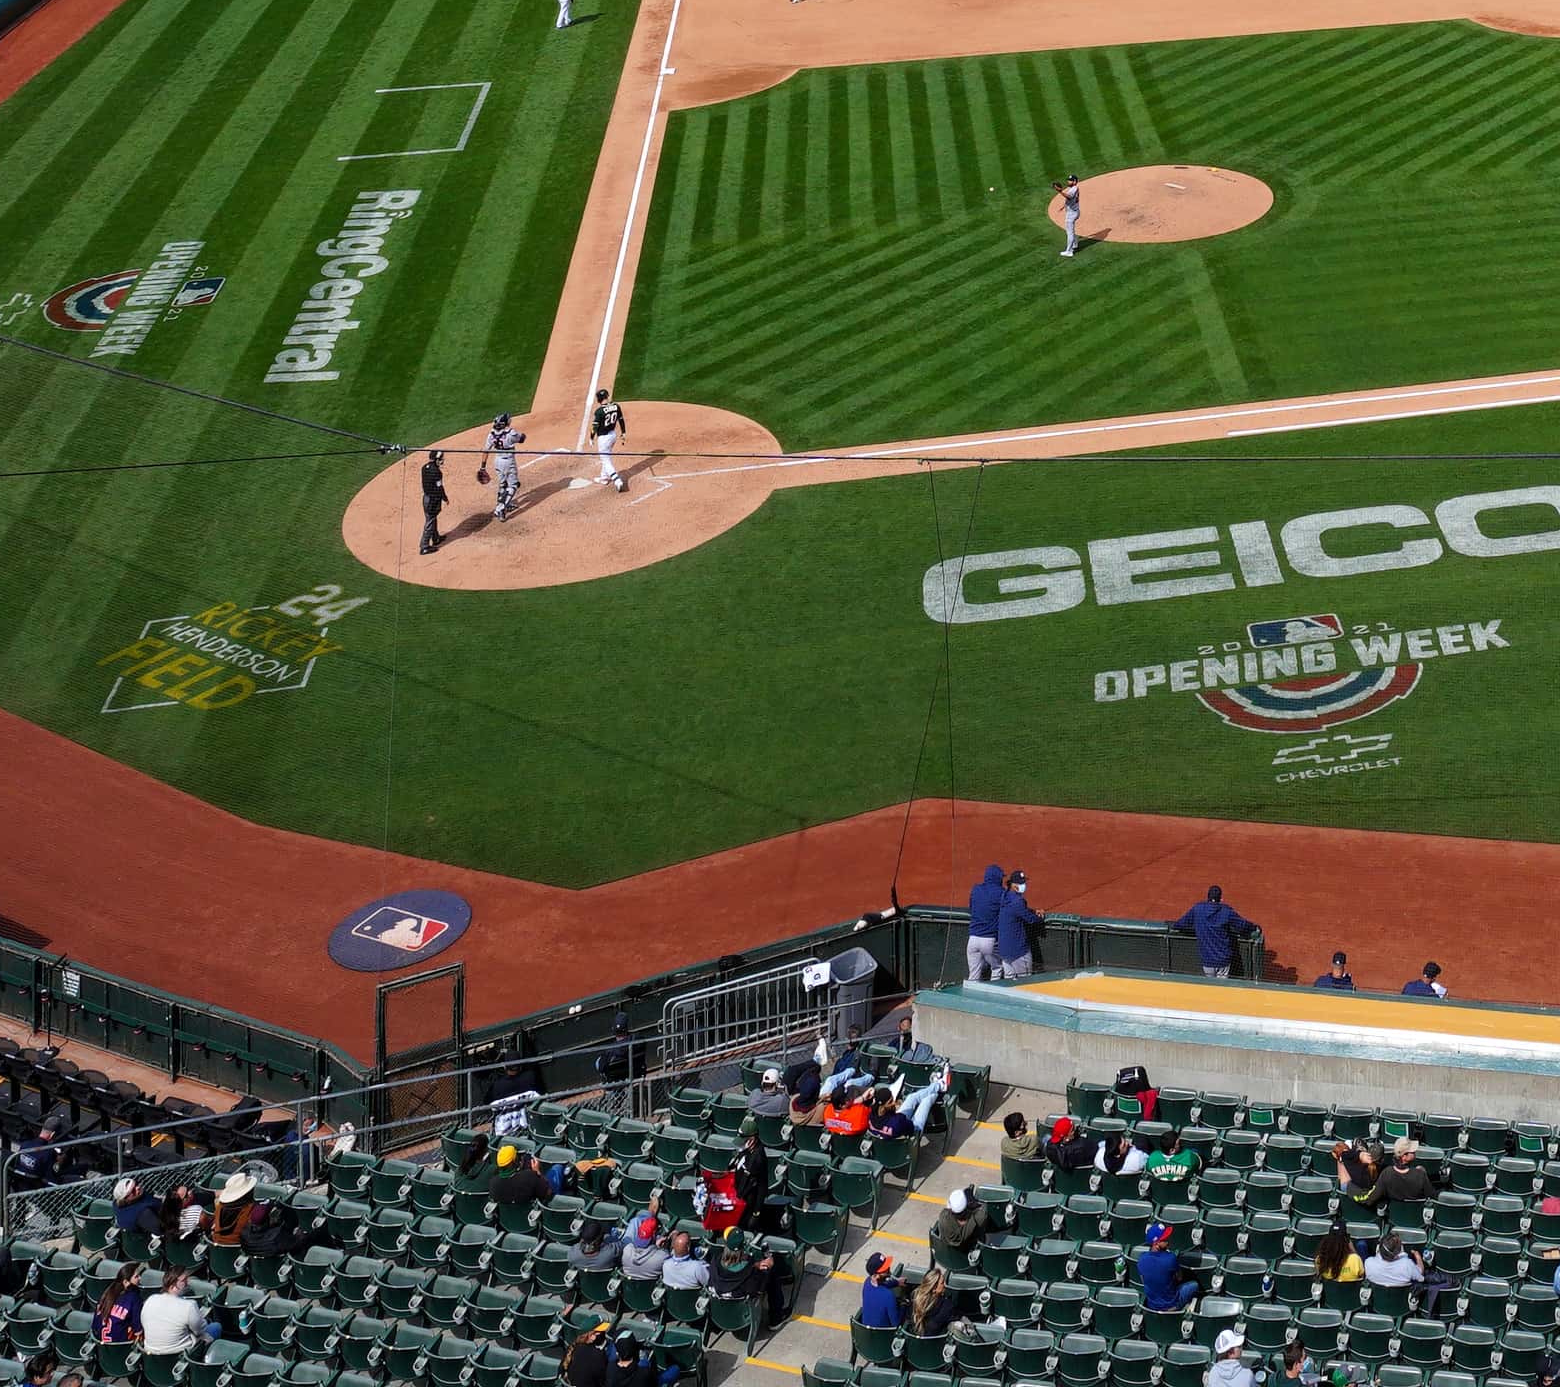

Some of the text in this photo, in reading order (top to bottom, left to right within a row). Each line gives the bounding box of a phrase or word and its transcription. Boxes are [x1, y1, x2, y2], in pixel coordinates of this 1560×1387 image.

[263, 189, 422, 383] RingCentral
[604, 412, 618, 426] 20
[193, 601, 344, 663] RICKEY
[276, 584, 371, 627] 24
[161, 622, 299, 684] HENDERSON
[1094, 619, 1511, 702] OPENING WEEK
[1197, 622, 1396, 655] 20 21
[96, 637, 256, 711] FIELD
[1275, 756, 1403, 784] CHEVROLET
